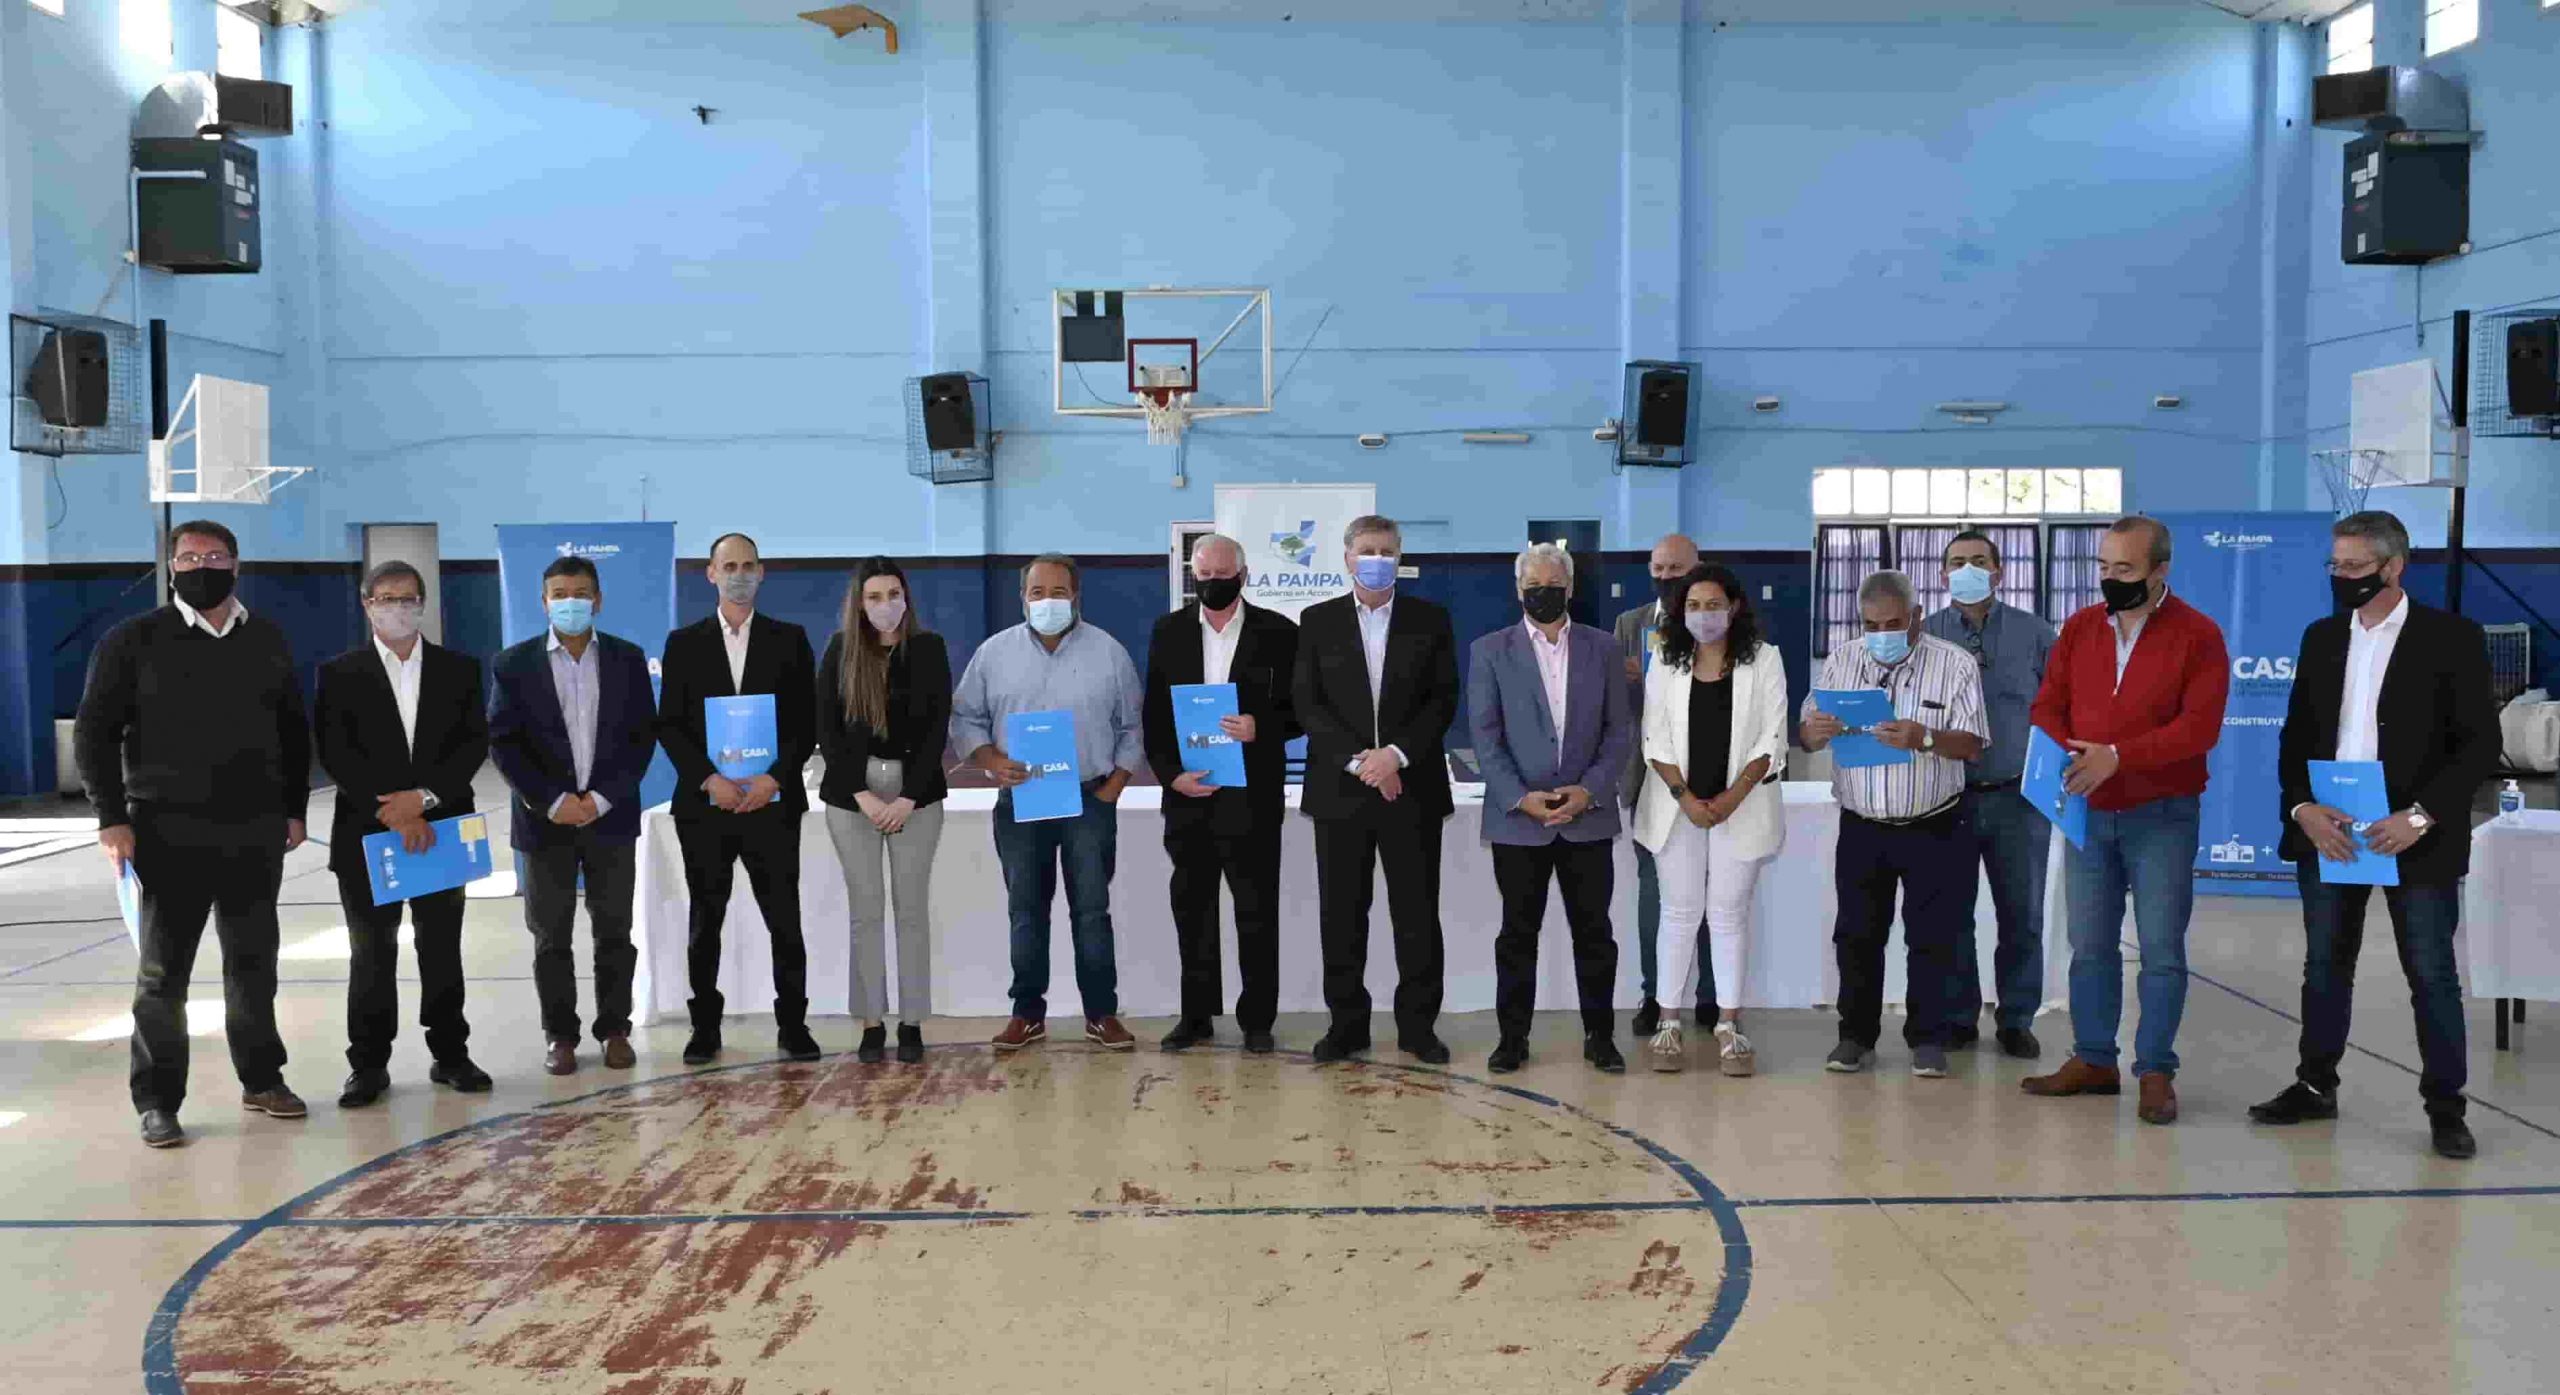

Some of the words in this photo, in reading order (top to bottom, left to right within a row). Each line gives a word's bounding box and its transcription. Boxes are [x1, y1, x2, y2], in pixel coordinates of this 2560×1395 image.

[1246, 573, 1271, 588] LA
[1277, 573, 1344, 587] PAMPA
[1208, 735, 1234, 744] CASA
[742, 747, 769, 758] CASA
[1043, 761, 1070, 773] CASA
